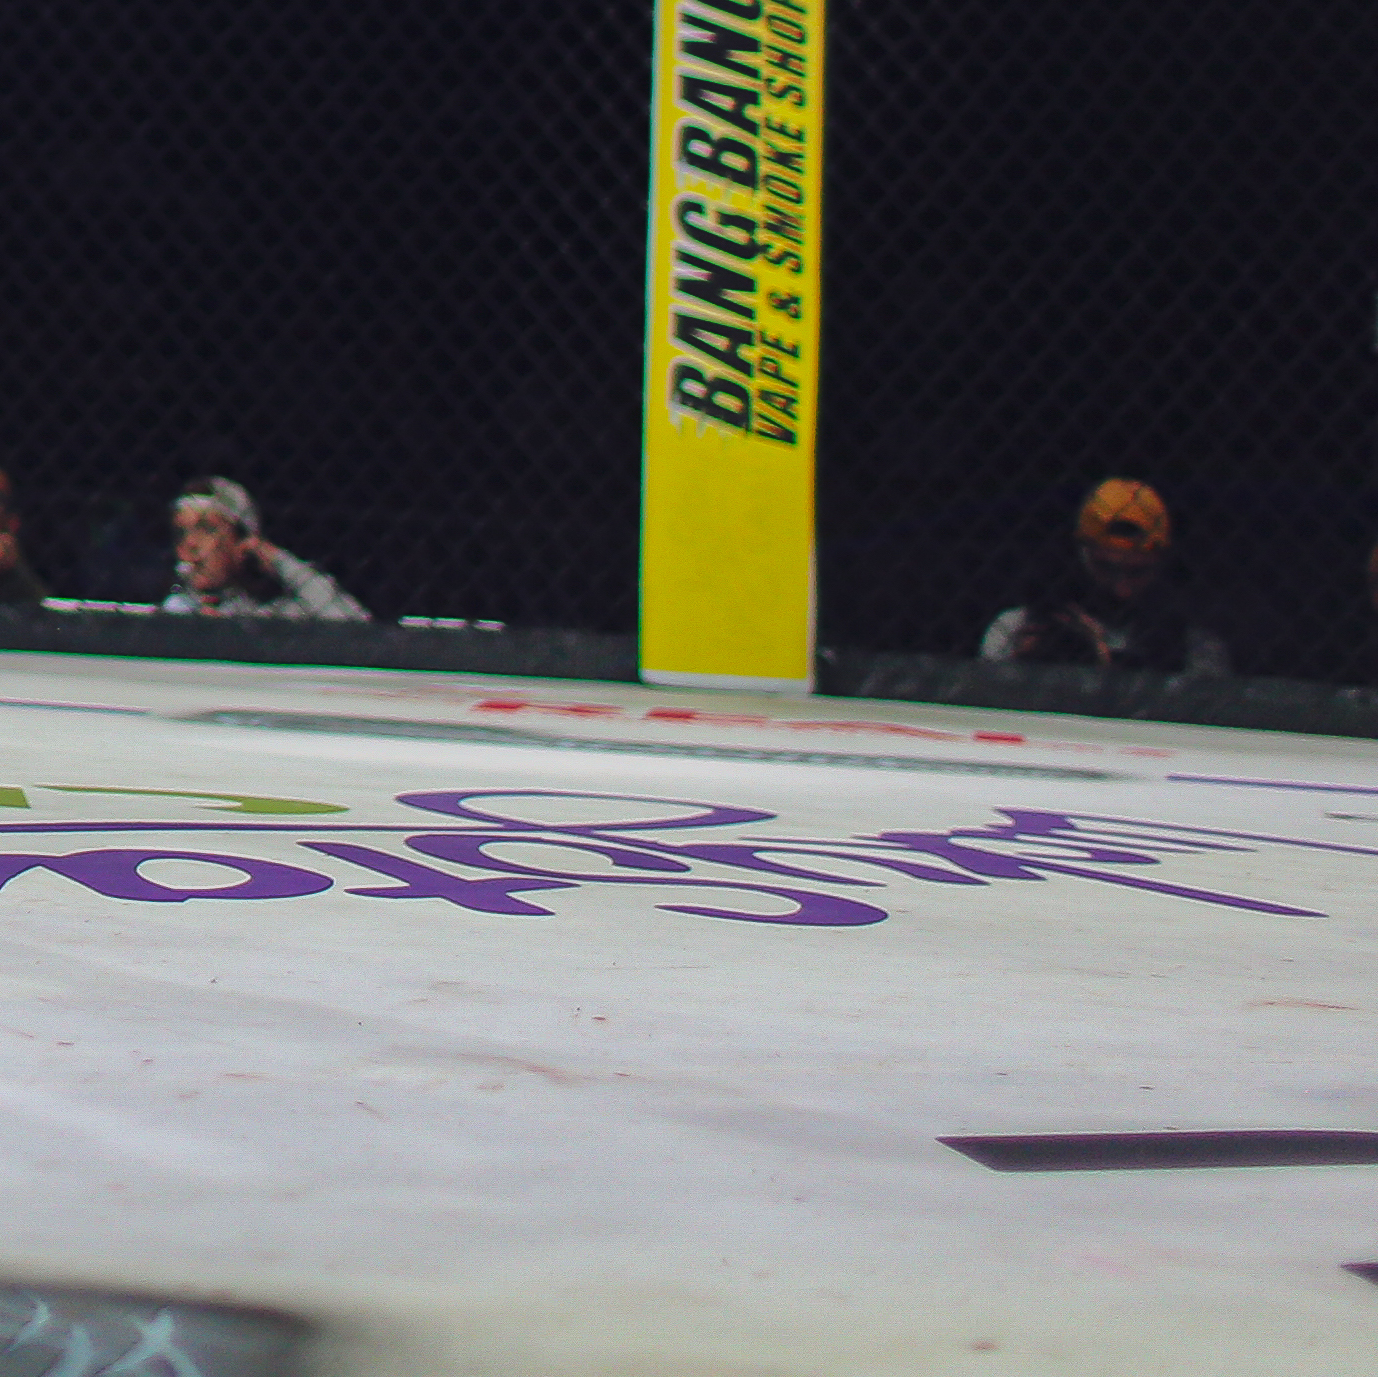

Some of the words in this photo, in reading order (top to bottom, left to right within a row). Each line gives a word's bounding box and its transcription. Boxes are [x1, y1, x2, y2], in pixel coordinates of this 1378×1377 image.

[760, 114, 807, 274] SMOKE
[672, 198, 758, 436] BANG
[768, 290, 802, 319] &
[755, 327, 801, 446] VAPE
